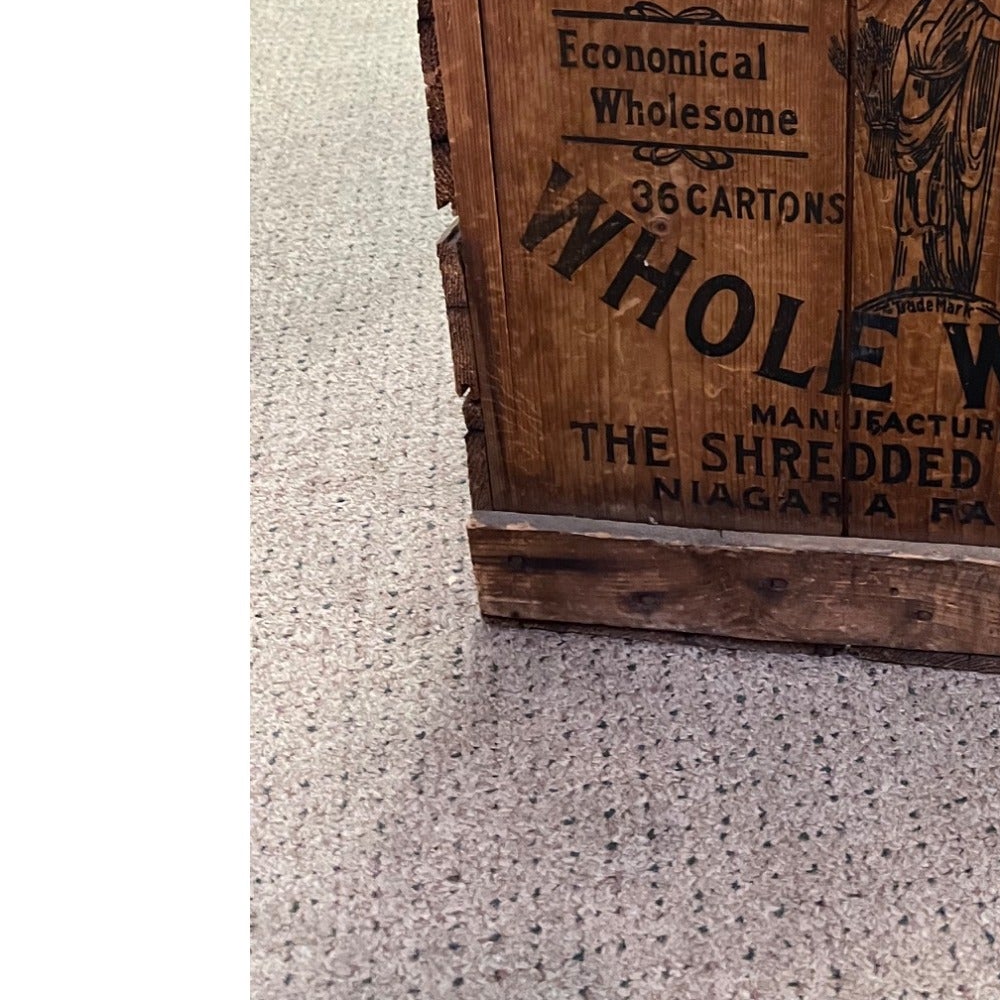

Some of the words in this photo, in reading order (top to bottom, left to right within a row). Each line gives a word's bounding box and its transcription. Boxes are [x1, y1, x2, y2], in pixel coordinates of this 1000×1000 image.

[558, 29, 767, 81] Economical
[590, 87, 798, 136] Wholesome
[520, 160, 900, 403] WHOLE
[892, 298, 934, 315] Trade
[936, 297, 974, 318] Mark
[570, 420, 671, 467] THE
[702, 433, 982, 490] SHREDDED
[653, 478, 896, 520] NIAGARA
